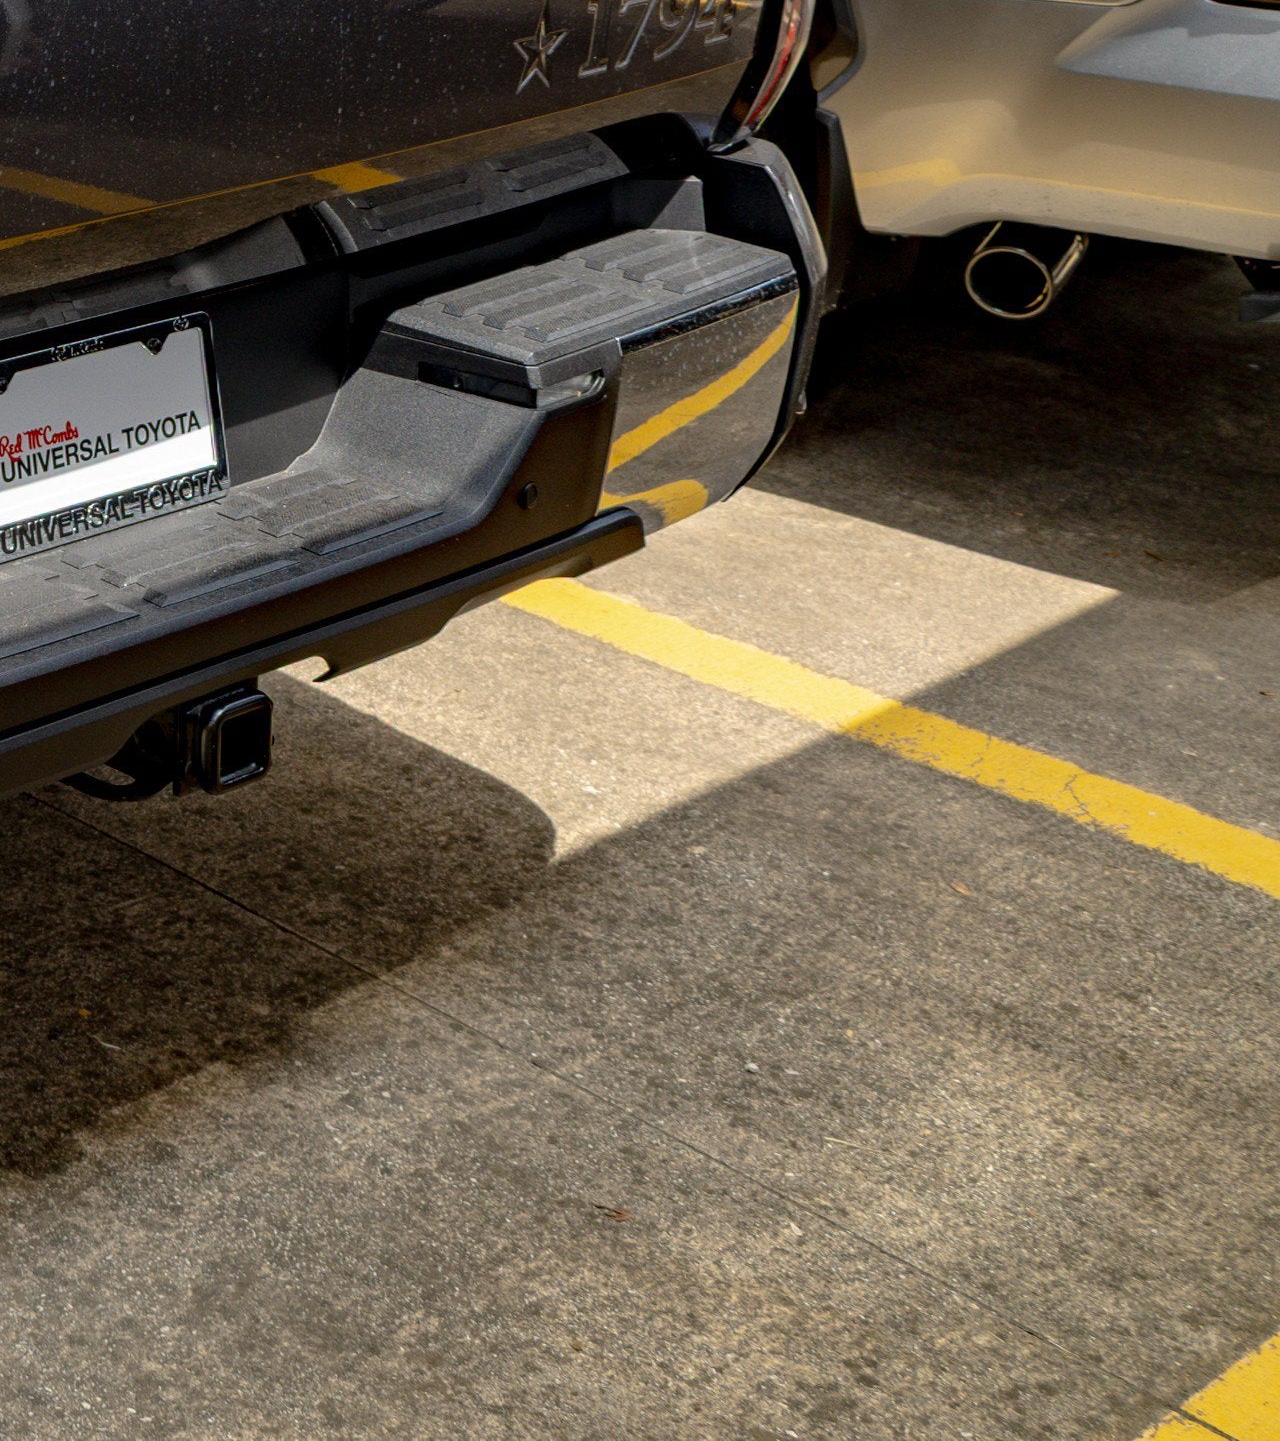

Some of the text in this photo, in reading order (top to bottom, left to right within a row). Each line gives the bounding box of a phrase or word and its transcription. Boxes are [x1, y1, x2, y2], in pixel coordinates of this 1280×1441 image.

[0, 409, 202, 483] UNIVERSAL TOYOTA
[0, 469, 225, 555] UNIVERSAL TOYOTA
